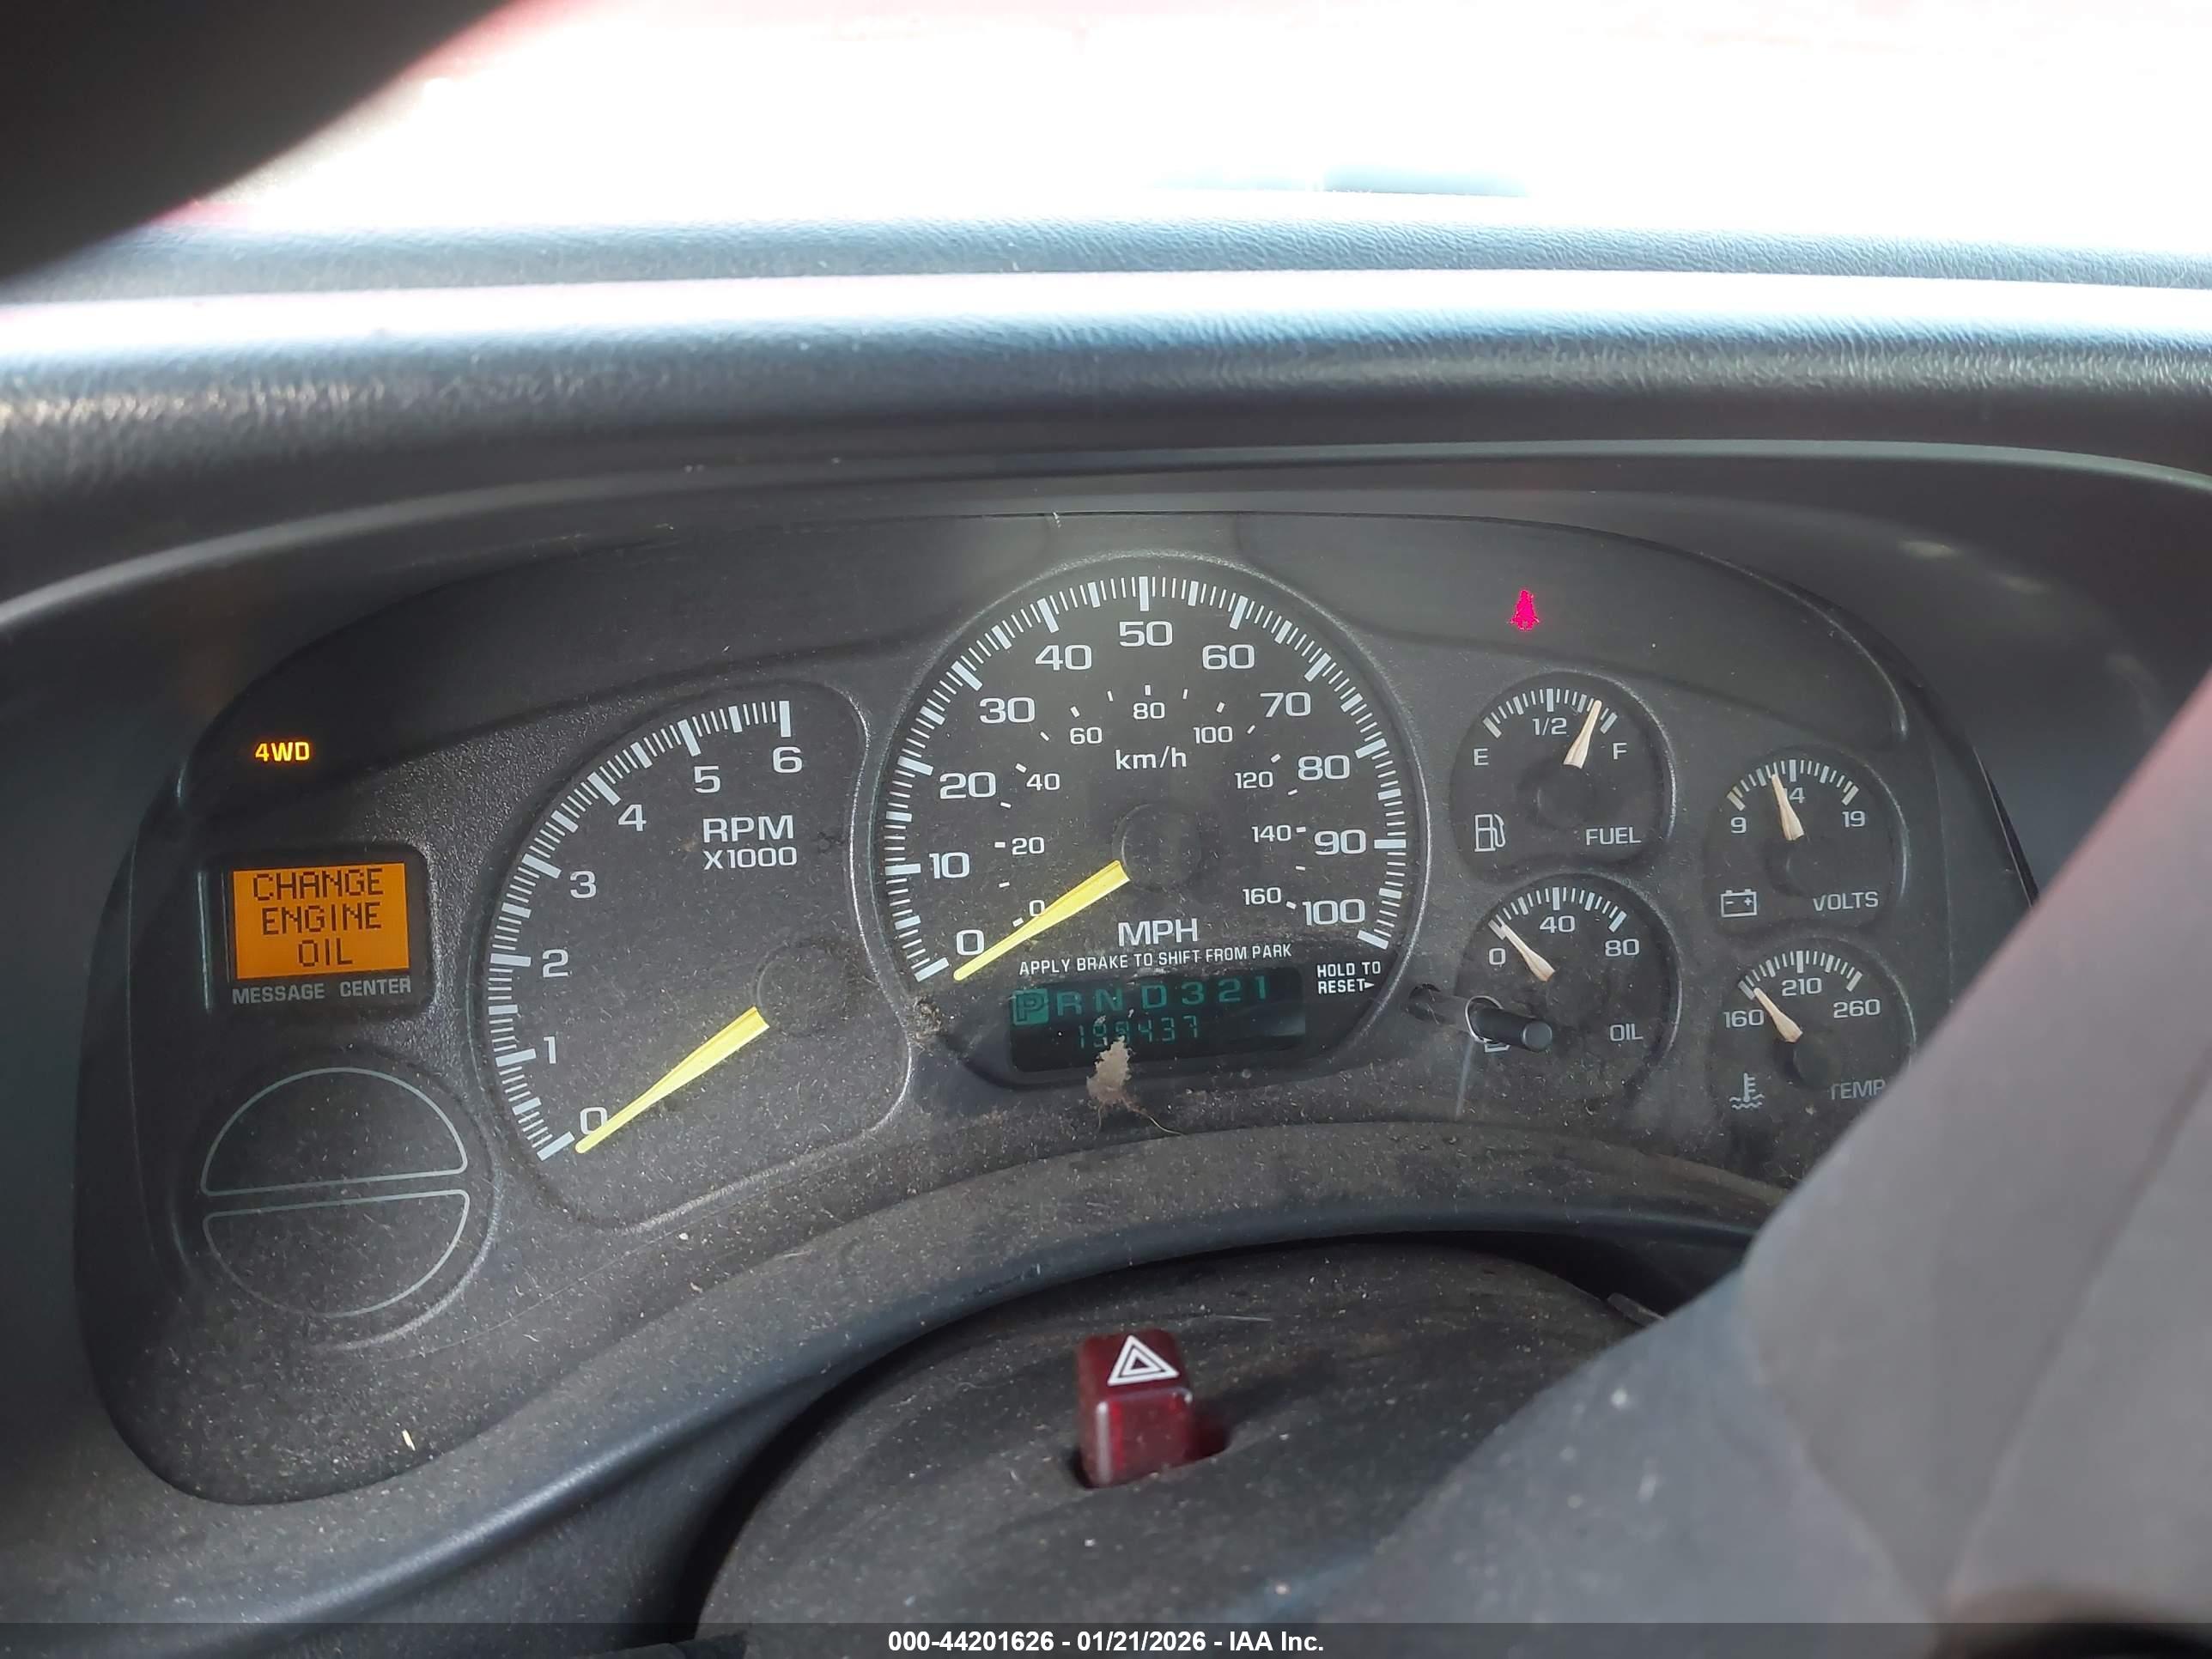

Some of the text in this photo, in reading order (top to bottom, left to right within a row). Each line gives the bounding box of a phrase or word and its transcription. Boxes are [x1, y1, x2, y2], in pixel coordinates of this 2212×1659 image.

[1119, 621, 1173, 647] 50
[1035, 644, 1092, 671] 40
[1202, 644, 1255, 670] 60
[980, 697, 1035, 724] 30
[1133, 702, 1165, 720] 80
[1260, 691, 1311, 718] 70
[1070, 727, 1103, 745] 60
[1194, 726, 1233, 744] 100
[1532, 718, 1567, 736] 1/2
[255, 741, 311, 763] 4WD
[773, 746, 803, 773] 6
[1115, 745, 1187, 770] km/h
[1474, 748, 1489, 766] E
[1613, 742, 1627, 759] F
[694, 765, 720, 793] 5
[1297, 755, 1350, 781] 80
[939, 772, 996, 799] 20
[1026, 774, 1060, 791] 40
[1235, 771, 1273, 789] 120
[618, 805, 647, 832] 4
[703, 815, 794, 843] RPM
[1730, 817, 1747, 834] 9
[1842, 811, 1865, 828] 19
[1252, 824, 1291, 842] 140
[1314, 830, 1366, 855] 90
[1585, 827, 1641, 846] FUEL
[1012, 836, 1045, 855] 20
[703, 847, 798, 870] X1000
[929, 852, 969, 879] 10
[253, 868, 384, 901] CHANGE
[570, 871, 597, 899] 3
[1243, 887, 1281, 905] 160
[1030, 899, 1046, 917] 0
[1303, 898, 1365, 926] 100
[1813, 891, 1879, 912] VOLTS
[262, 902, 382, 935] ENGINE
[1539, 915, 1576, 933] 40
[956, 929, 984, 957] 0
[1118, 918, 1198, 946] MPH
[298, 939, 353, 967] OIL
[1488, 948, 1506, 966] 0
[1604, 939, 1639, 957] 80
[543, 949, 569, 978] 2
[1019, 944, 1292, 976] APPLY BRAKE TO SHIFT FROM PARK
[1317, 961, 1382, 978] HOLD TO
[233, 975, 411, 1005] MESSAGE CENTER
[1317, 979, 1364, 994] RESET
[1782, 977, 1823, 996] 210
[1015, 975, 1267, 1022] P R N D 3 2 1
[1833, 999, 1881, 1018] 260
[1724, 1009, 1765, 1028] 160
[1609, 1024, 1644, 1042] OIL
[543, 1036, 556, 1064] 1
[1830, 1079, 1887, 1100] TEMP
[580, 1107, 607, 1135] 0
